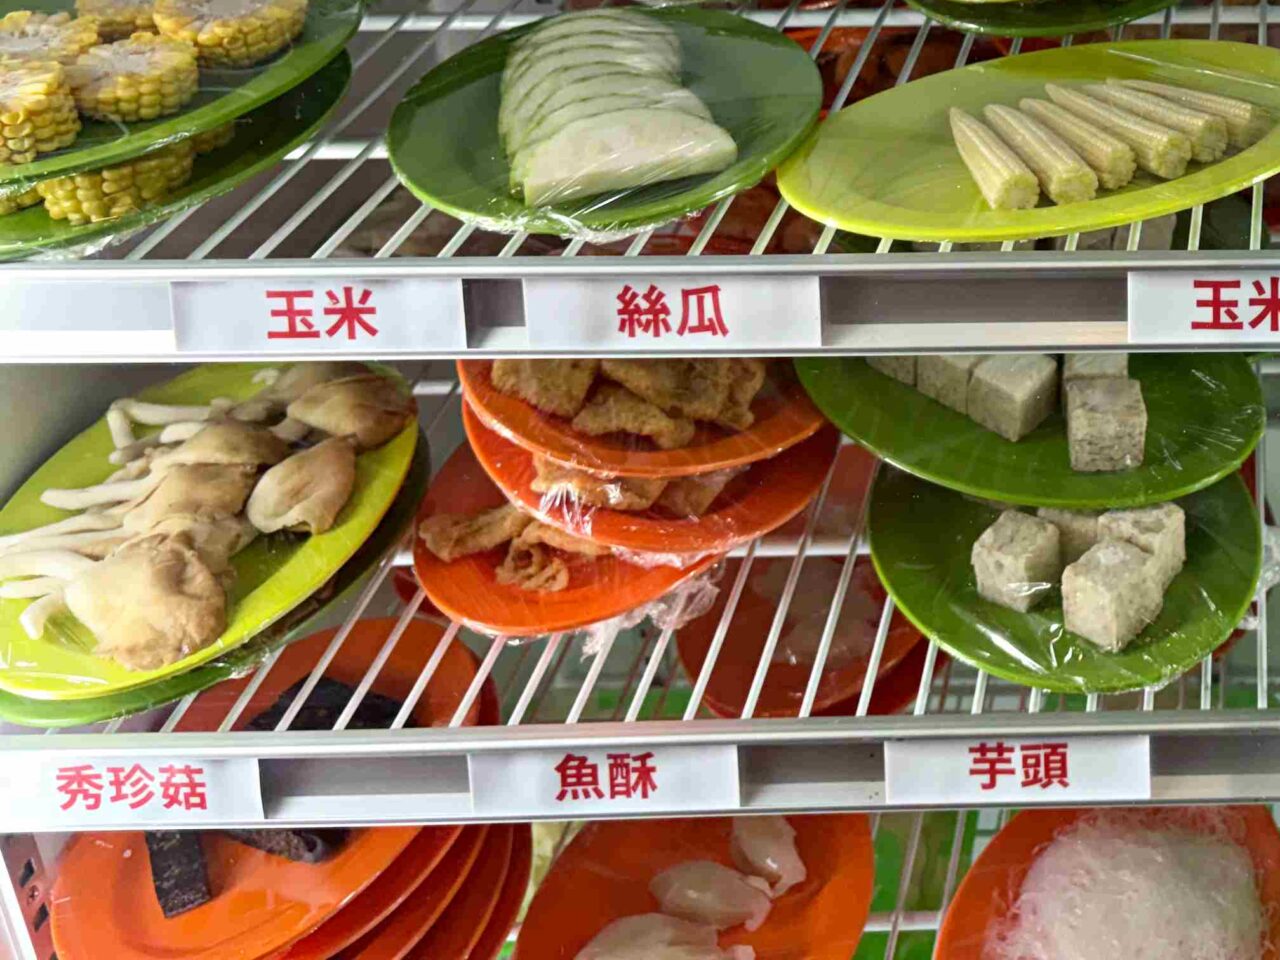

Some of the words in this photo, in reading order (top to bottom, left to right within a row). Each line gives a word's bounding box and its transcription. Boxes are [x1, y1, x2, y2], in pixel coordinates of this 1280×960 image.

[265, 286, 378, 340] 玉米
[616, 284, 729, 337] 絲瓜
[56, 763, 208, 810] 秀珍菇
[554, 751, 658, 802] 魚酥
[968, 741, 1070, 790] 芋頭
